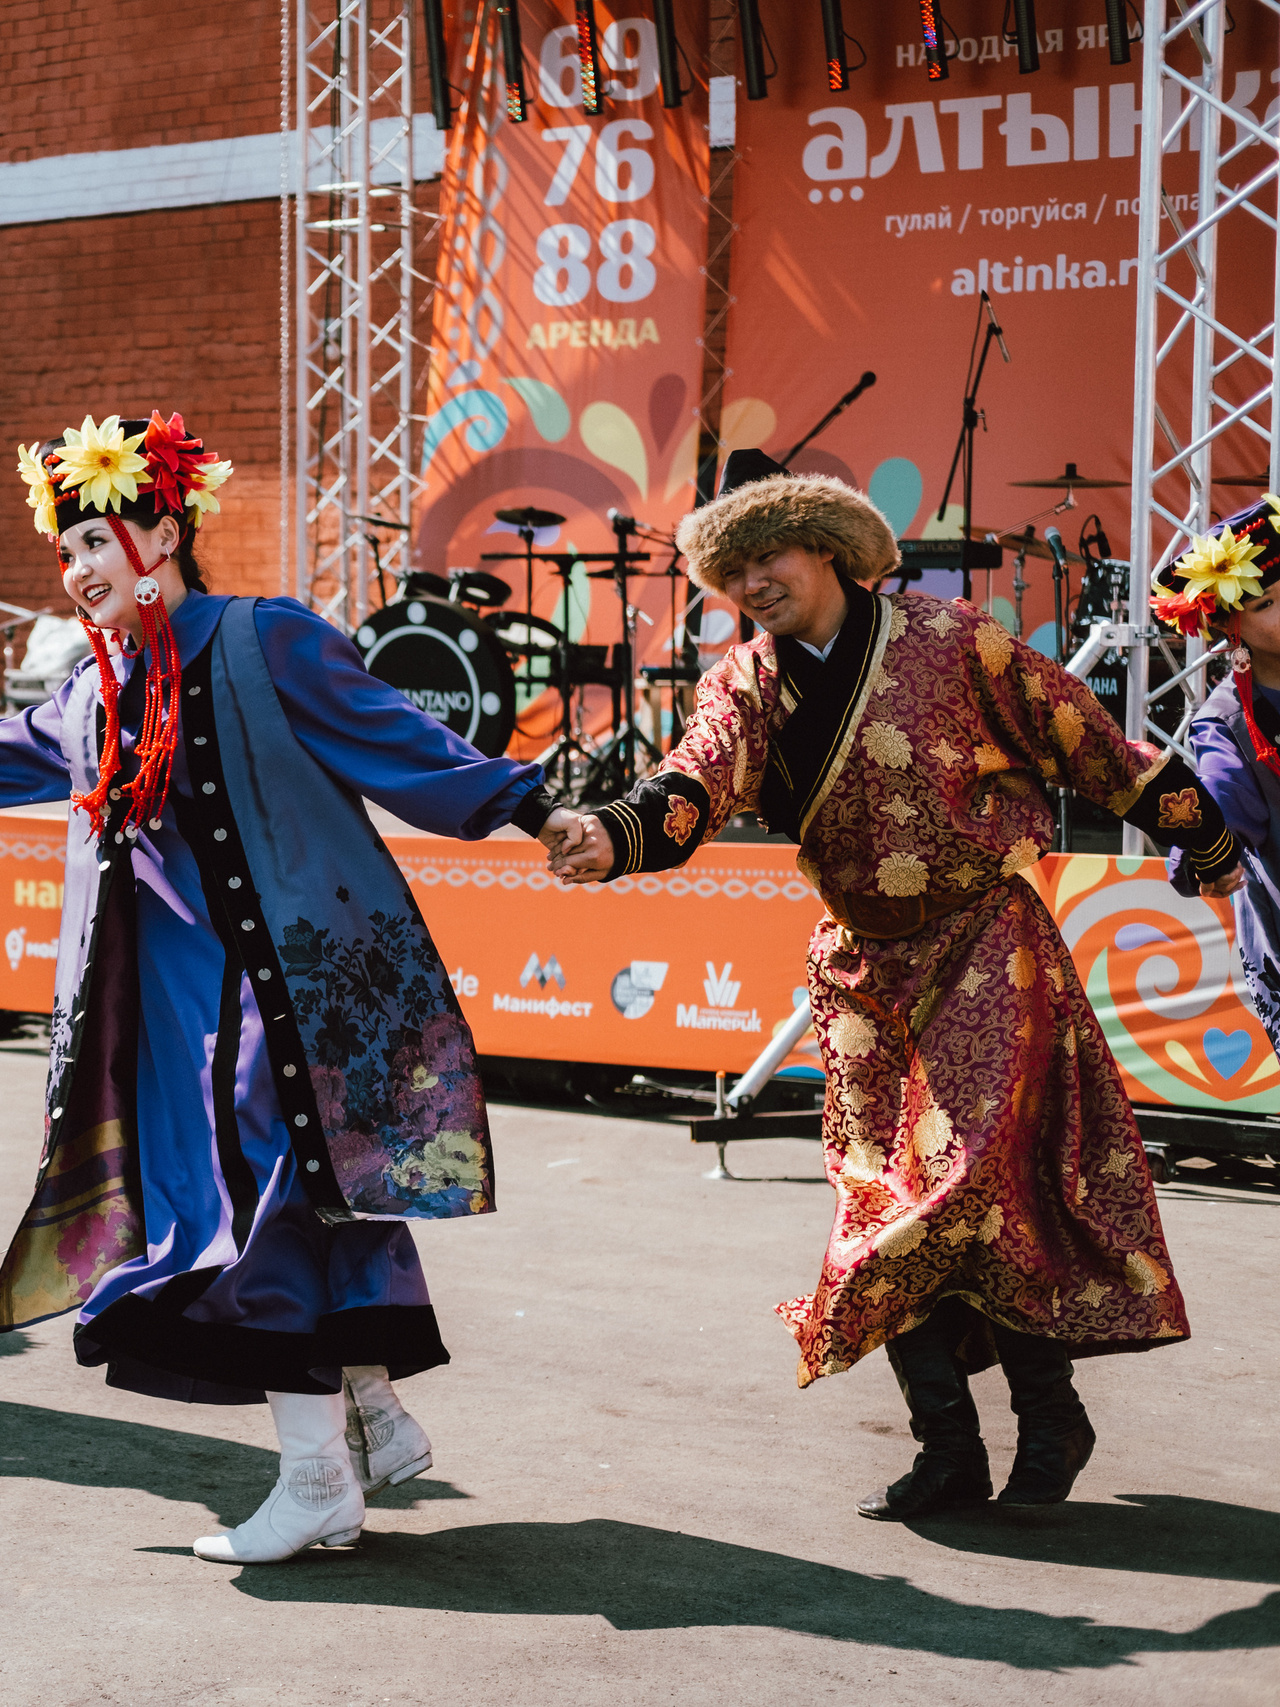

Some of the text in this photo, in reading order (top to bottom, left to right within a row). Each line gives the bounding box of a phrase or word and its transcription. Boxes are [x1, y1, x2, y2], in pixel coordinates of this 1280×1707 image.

[538, 17, 662, 109] 69
[895, 29, 1064, 67] НРОДНЯ
[802, 68, 1280, 182] алтынк
[541, 118, 656, 206] 76
[885, 206, 953, 238] гуляй
[978, 197, 1087, 231] торгуйся
[533, 219, 657, 307] 88
[525, 318, 660, 349] АРЕНДА
[493, 992, 593, 1019] Манифест
